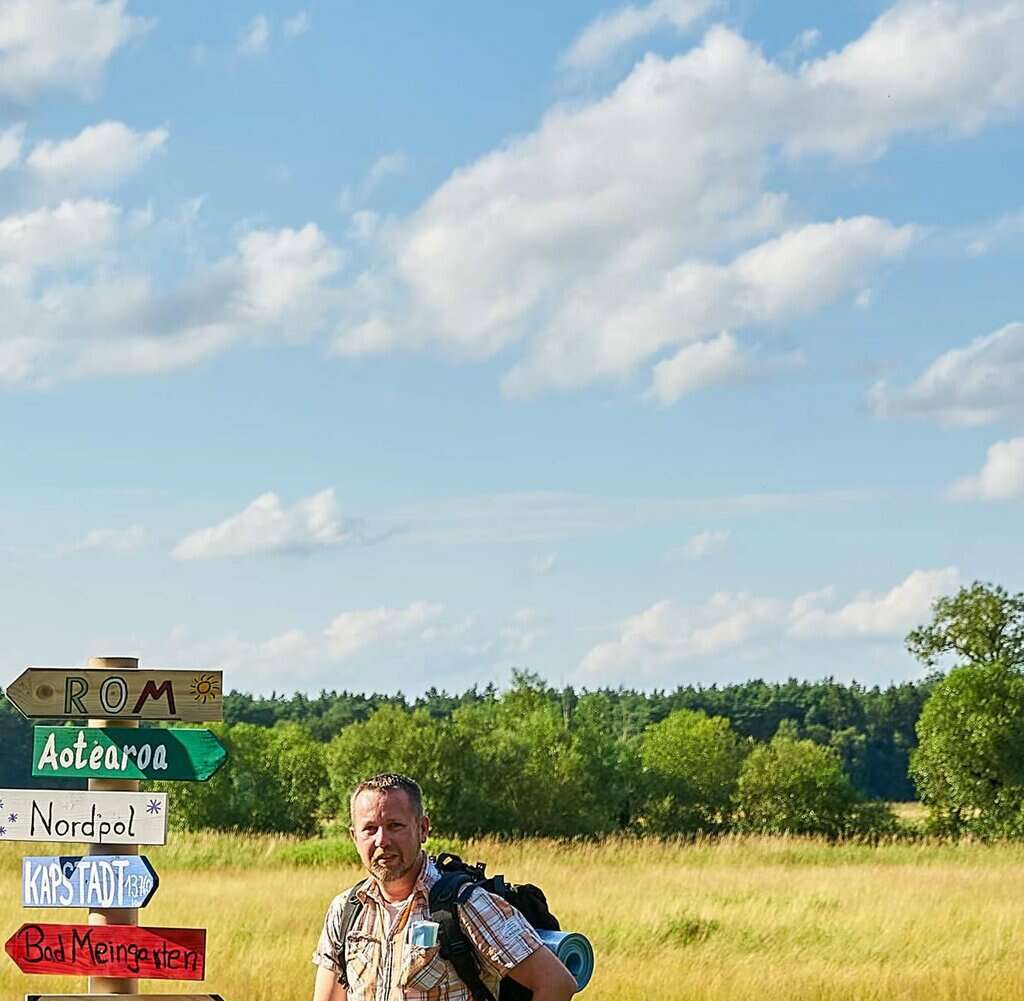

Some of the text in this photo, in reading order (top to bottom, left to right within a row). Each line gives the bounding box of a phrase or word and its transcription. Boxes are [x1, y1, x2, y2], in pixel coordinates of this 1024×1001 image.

[63, 676, 177, 715] ROM
[37, 730, 168, 771] Aotearoa
[30, 800, 135, 843] Nordpol
[25, 860, 129, 906] KAPSTADT
[17, 924, 198, 973] Bad Meingarten
